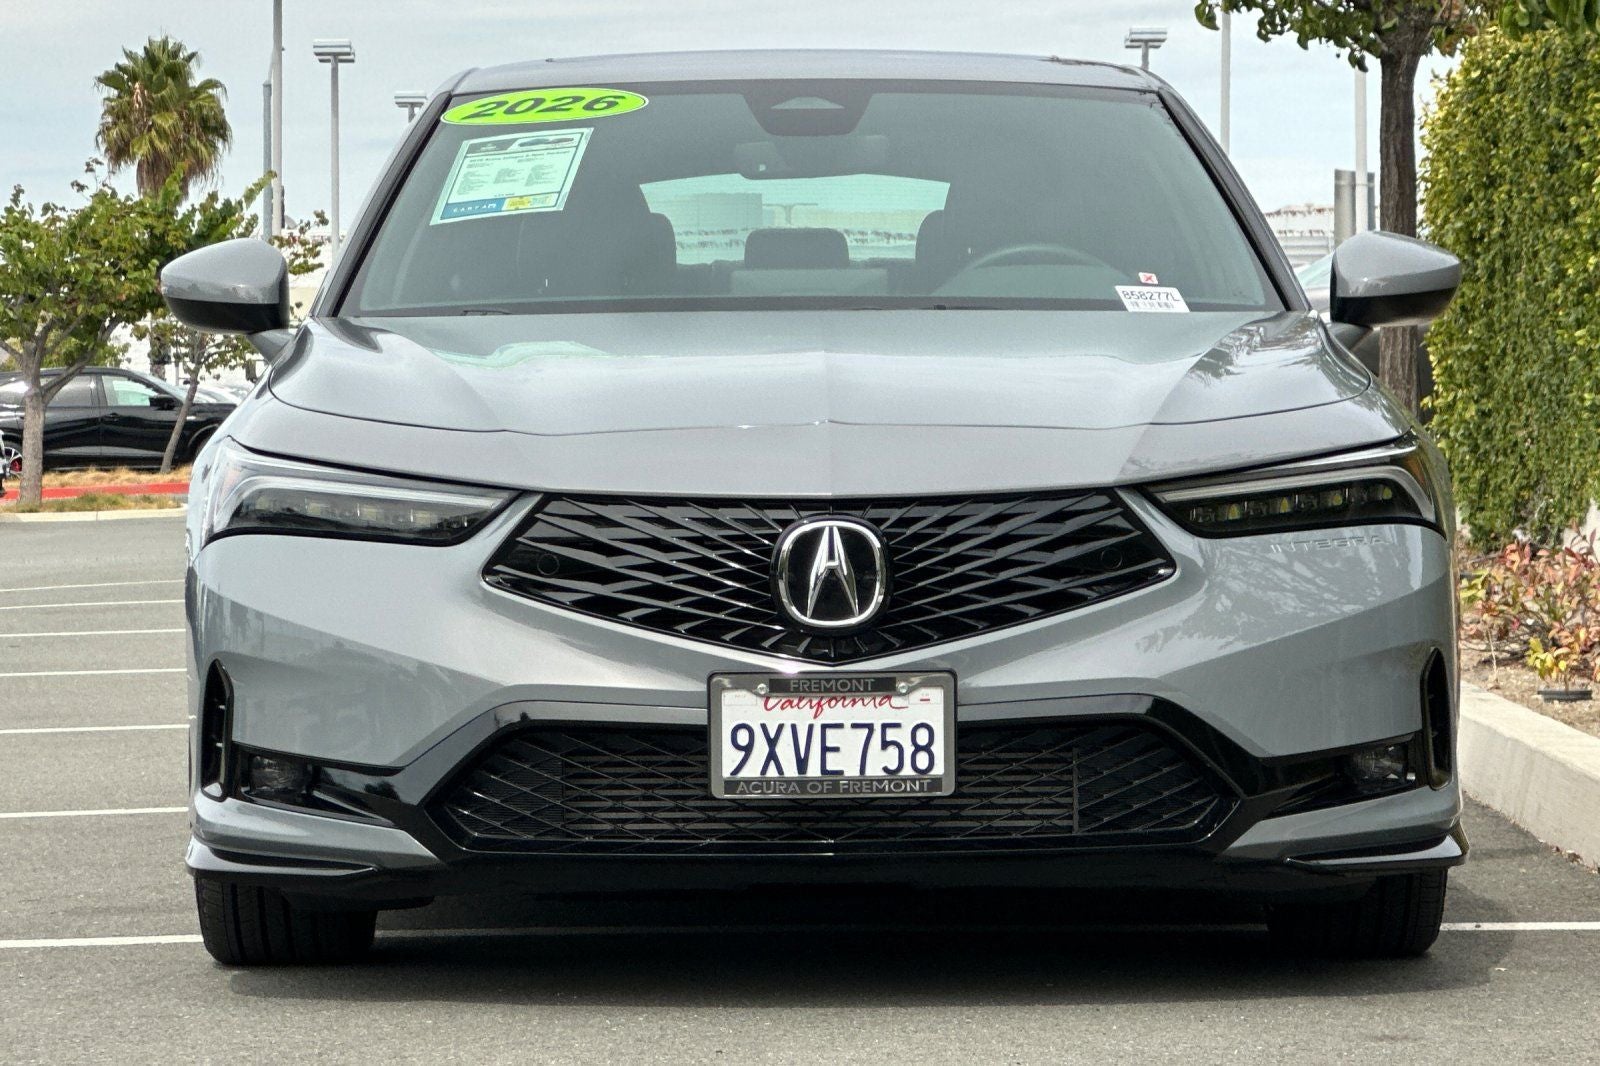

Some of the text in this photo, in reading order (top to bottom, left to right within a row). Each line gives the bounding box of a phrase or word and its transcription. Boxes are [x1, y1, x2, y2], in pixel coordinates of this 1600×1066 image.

[459, 95, 628, 121] 2026
[1121, 290, 1181, 302] 858277L
[790, 678, 876, 692] FREMONT
[729, 722, 936, 776] 9XVE758
[736, 779, 932, 795] ACURA OF FREMONT
